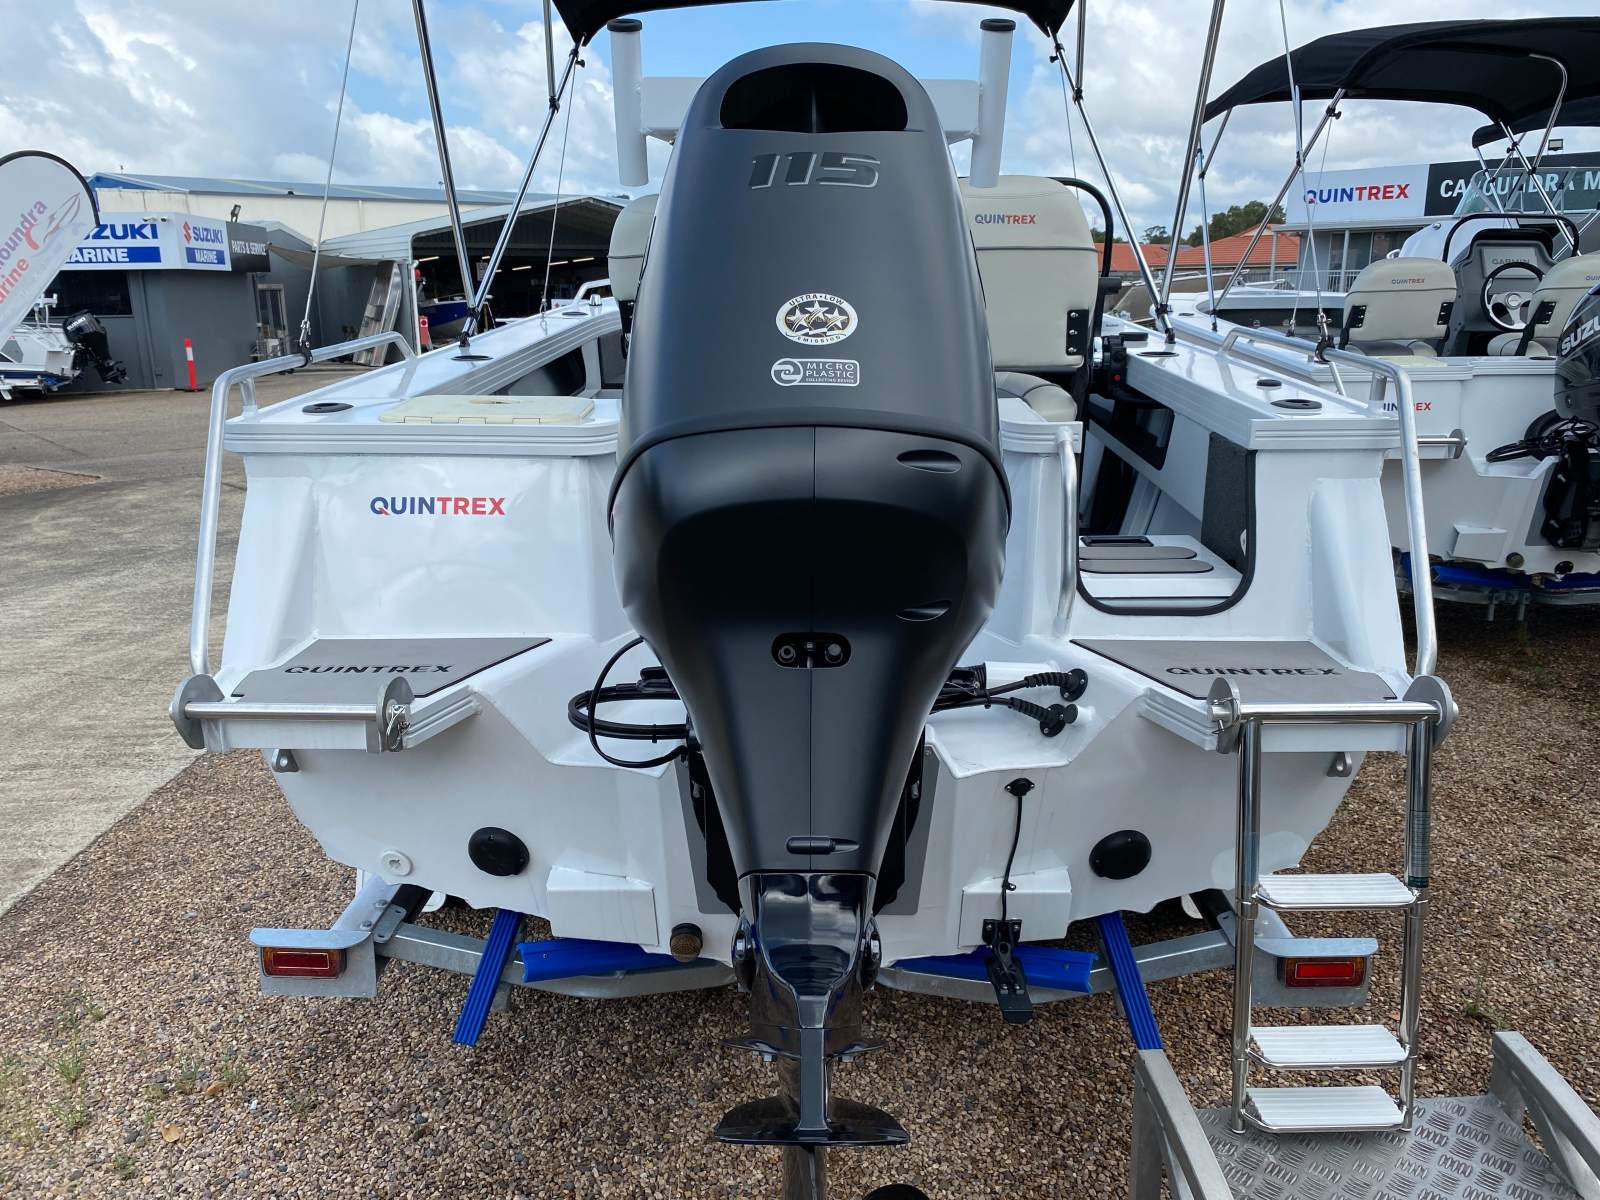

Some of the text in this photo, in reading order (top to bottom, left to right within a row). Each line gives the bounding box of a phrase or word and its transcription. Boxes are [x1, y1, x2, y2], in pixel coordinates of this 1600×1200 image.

[748, 151, 880, 190] 115
[1304, 184, 1410, 204] QUINTREX
[974, 213, 1037, 225] QUINTREX
[86, 223, 159, 240] ZUKI
[192, 226, 224, 244] SUZUKI
[69, 247, 130, 263] ARINE
[195, 249, 218, 264] MARINE
[806, 362, 854, 371] MICRO
[806, 370, 855, 379] PLASTIC
[370, 496, 505, 516] QUINTREX
[284, 665, 454, 674] QUINTREX
[1166, 667, 1343, 676] QUINTREX
